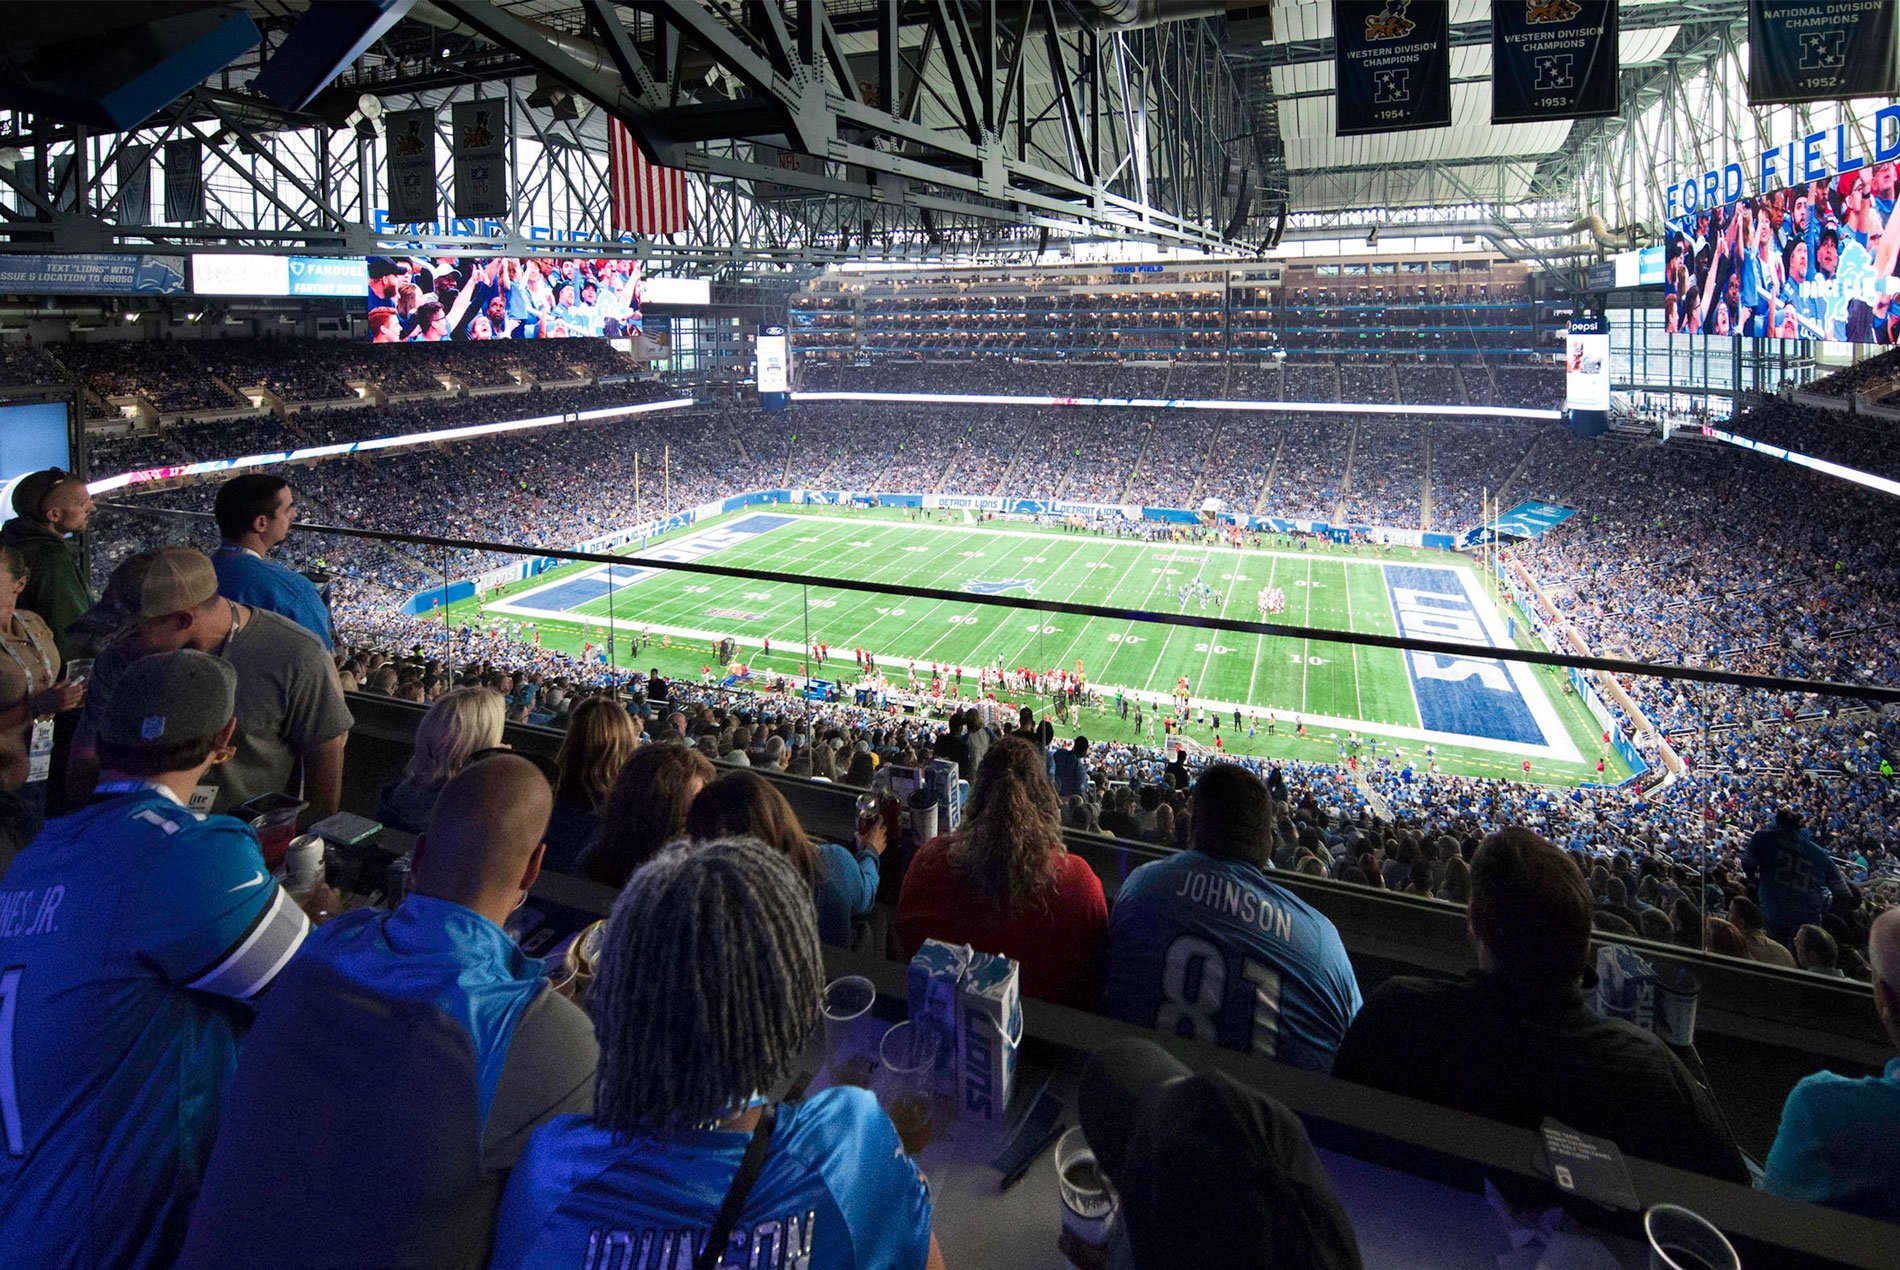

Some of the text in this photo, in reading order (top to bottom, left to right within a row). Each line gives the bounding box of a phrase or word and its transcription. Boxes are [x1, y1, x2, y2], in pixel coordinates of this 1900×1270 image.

[1763, 1, 1882, 20] NATIONAL DIVISION
[1785, 14, 1859, 28] CHAMPIONS
[1504, 26, 1604, 43] WESTERN DIVISION
[1346, 41, 1437, 59] WESTERN DIVISION
[1522, 38, 1586, 52] CHAMPIONS
[1363, 54, 1420, 67] CHAMPIONS
[1806, 77, 1837, 88] 1952
[1540, 97, 1567, 108] 1953
[1380, 109, 1404, 119] 1954
[1666, 103, 1900, 220] FORD FIELD
[46, 263, 135, 275] TEXT "LIONS" WITH
[307, 264, 365, 277] FANDUEL
[1112, 264, 1164, 274] FORD FIELD
[0, 272, 26, 281] SSUE
[38, 273, 86, 283] LOCATION
[88, 274, 100, 283] TO
[103, 275, 133, 284] 69050
[1572, 321, 1598, 332] pepsi
[938, 497, 998, 509] DETROIT LIONS
[1060, 505, 1095, 516] DETROIT
[589, 535, 624, 554] DETOIT
[1106, 633, 1139, 644] 30
[1194, 643, 1228, 655] 20
[1290, 654, 1323, 666] 10
[25, 884, 67, 937] JR.
[1175, 870, 1292, 943] JOHNSON
[1156, 934, 1282, 1058] 81
